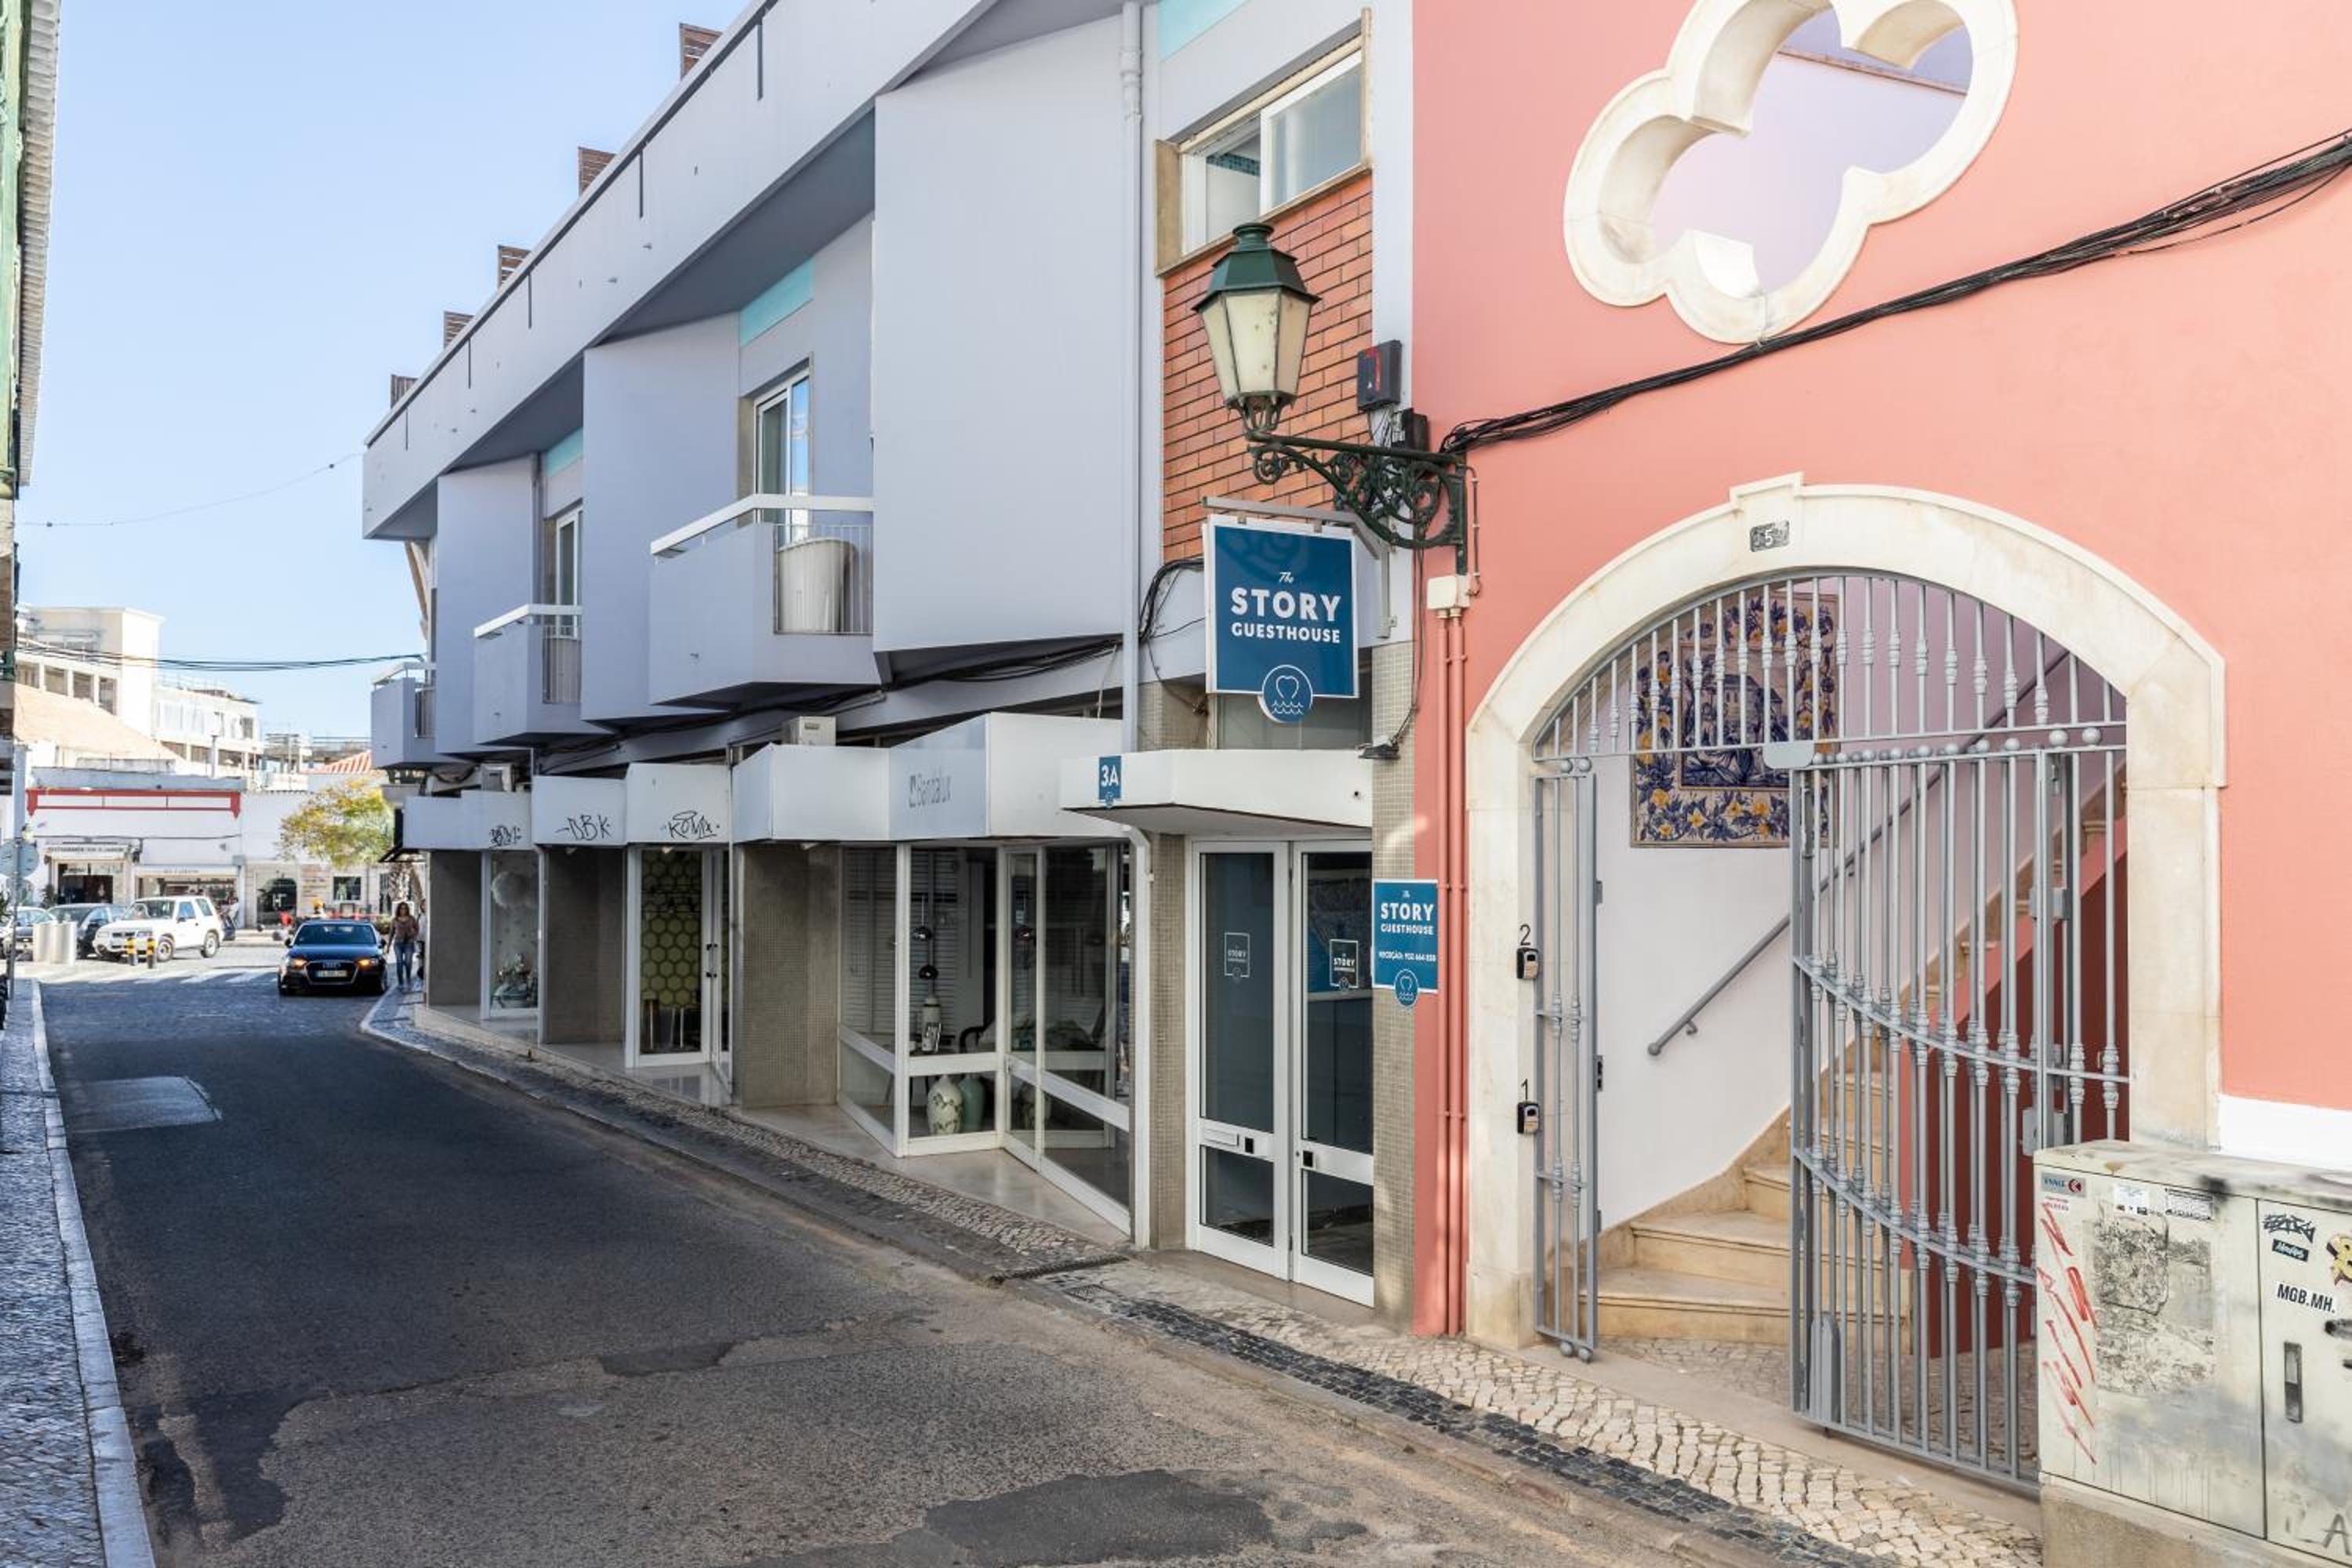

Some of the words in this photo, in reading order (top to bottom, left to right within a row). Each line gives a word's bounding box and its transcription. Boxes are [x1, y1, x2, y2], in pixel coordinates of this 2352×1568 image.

[1279, 572, 1294, 584] The
[1231, 587, 1341, 622] STORY
[1231, 622, 1340, 644] GUESTHOUSE
[1101, 764, 1119, 786] 3A
[1380, 902, 1434, 921] STORY
[1380, 923, 1434, 935] GUESTHOUSE
[1519, 924, 1531, 946] 2
[1334, 957, 1356, 967] STORY
[1521, 1079, 1529, 1099] 1
[2277, 1283, 2336, 1314] MGB.MH.
